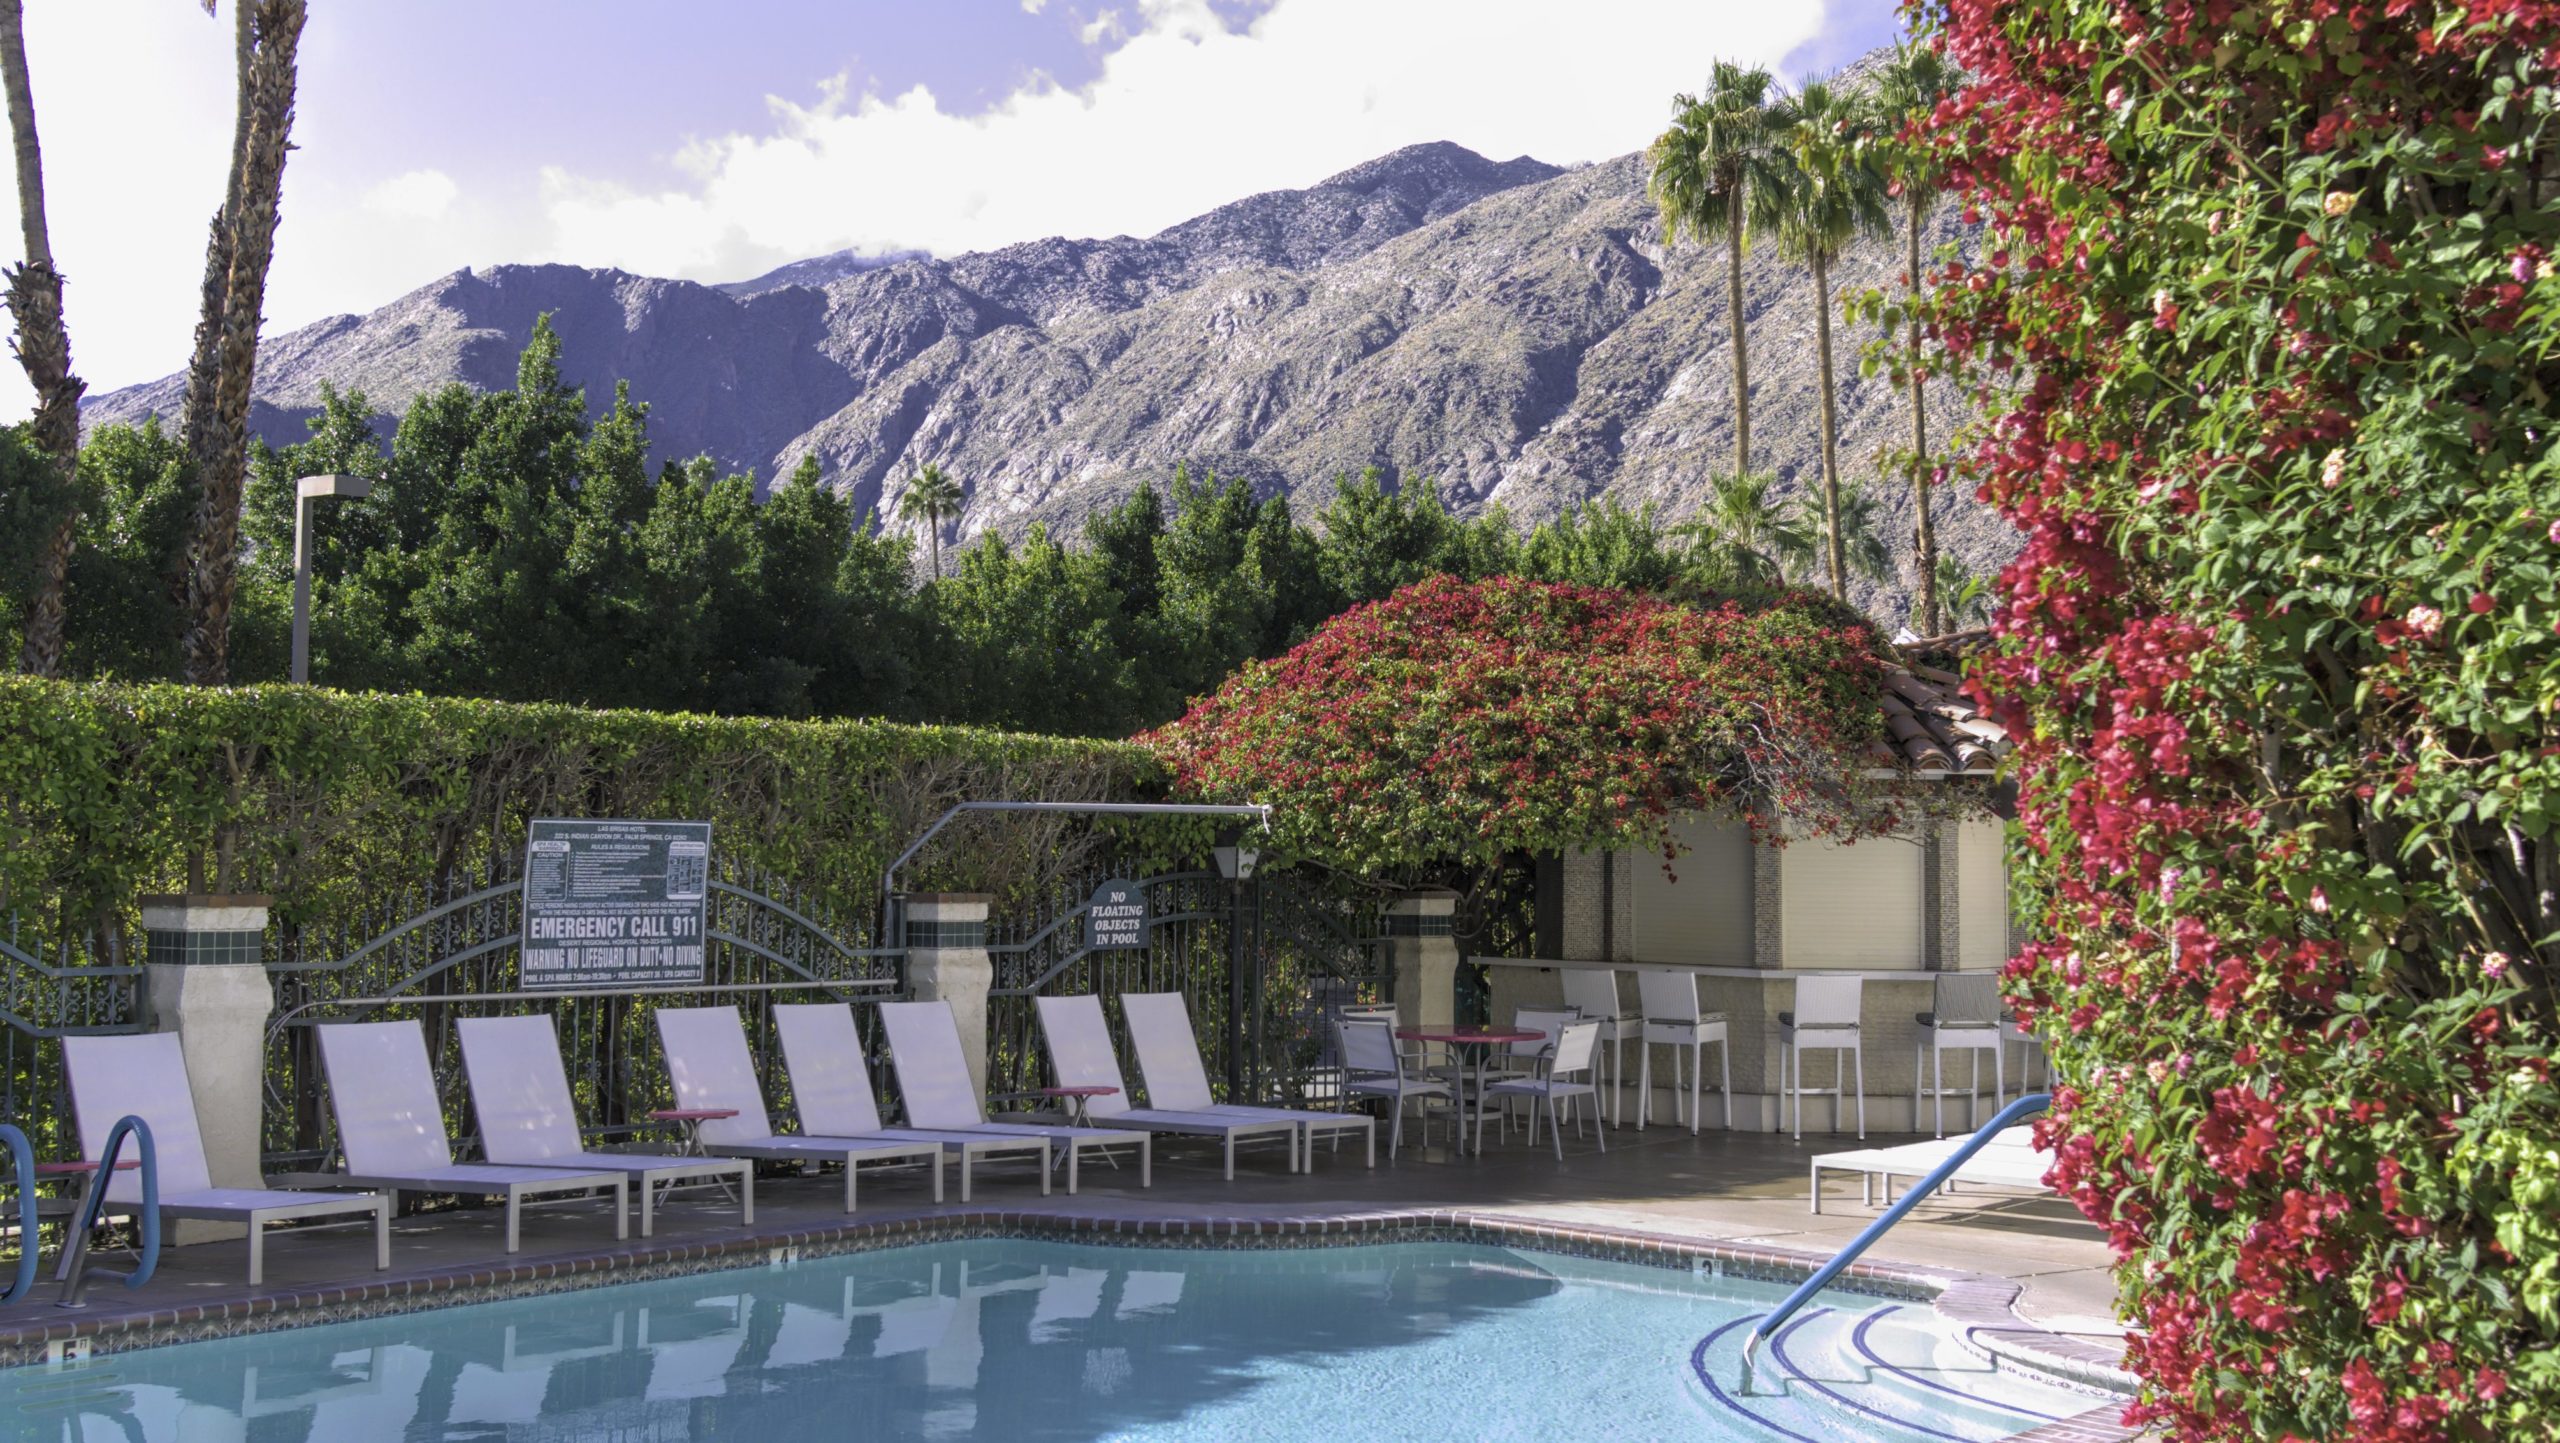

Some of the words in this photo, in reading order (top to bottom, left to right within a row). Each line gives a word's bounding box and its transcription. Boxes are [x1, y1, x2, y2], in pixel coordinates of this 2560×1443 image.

[1110, 892, 1126, 903] NO
[1092, 905, 1144, 917] FLOATING
[531, 916, 626, 939] EMERGENCY
[631, 916, 668, 937] CALL
[672, 916, 696, 936] 911
[1095, 920, 1140, 931] OBJECTS
[1096, 934, 1109, 945] IN
[1111, 933, 1139, 944] POOL
[526, 948, 565, 970] WARNING
[567, 948, 579, 968] NO
[582, 947, 624, 968] LIFEGUARD
[627, 947, 638, 967] ON
[676, 945, 702, 966] DIVING
[544, 974, 554, 982] SPA
[555, 973, 572, 981] HOURS
[618, 971, 630, 979] POOL
[631, 971, 653, 979] CAPACITY
[664, 970, 673, 978] SPA
[63, 1341, 76, 1360] 5
[80, 1339, 87, 1349] FT
